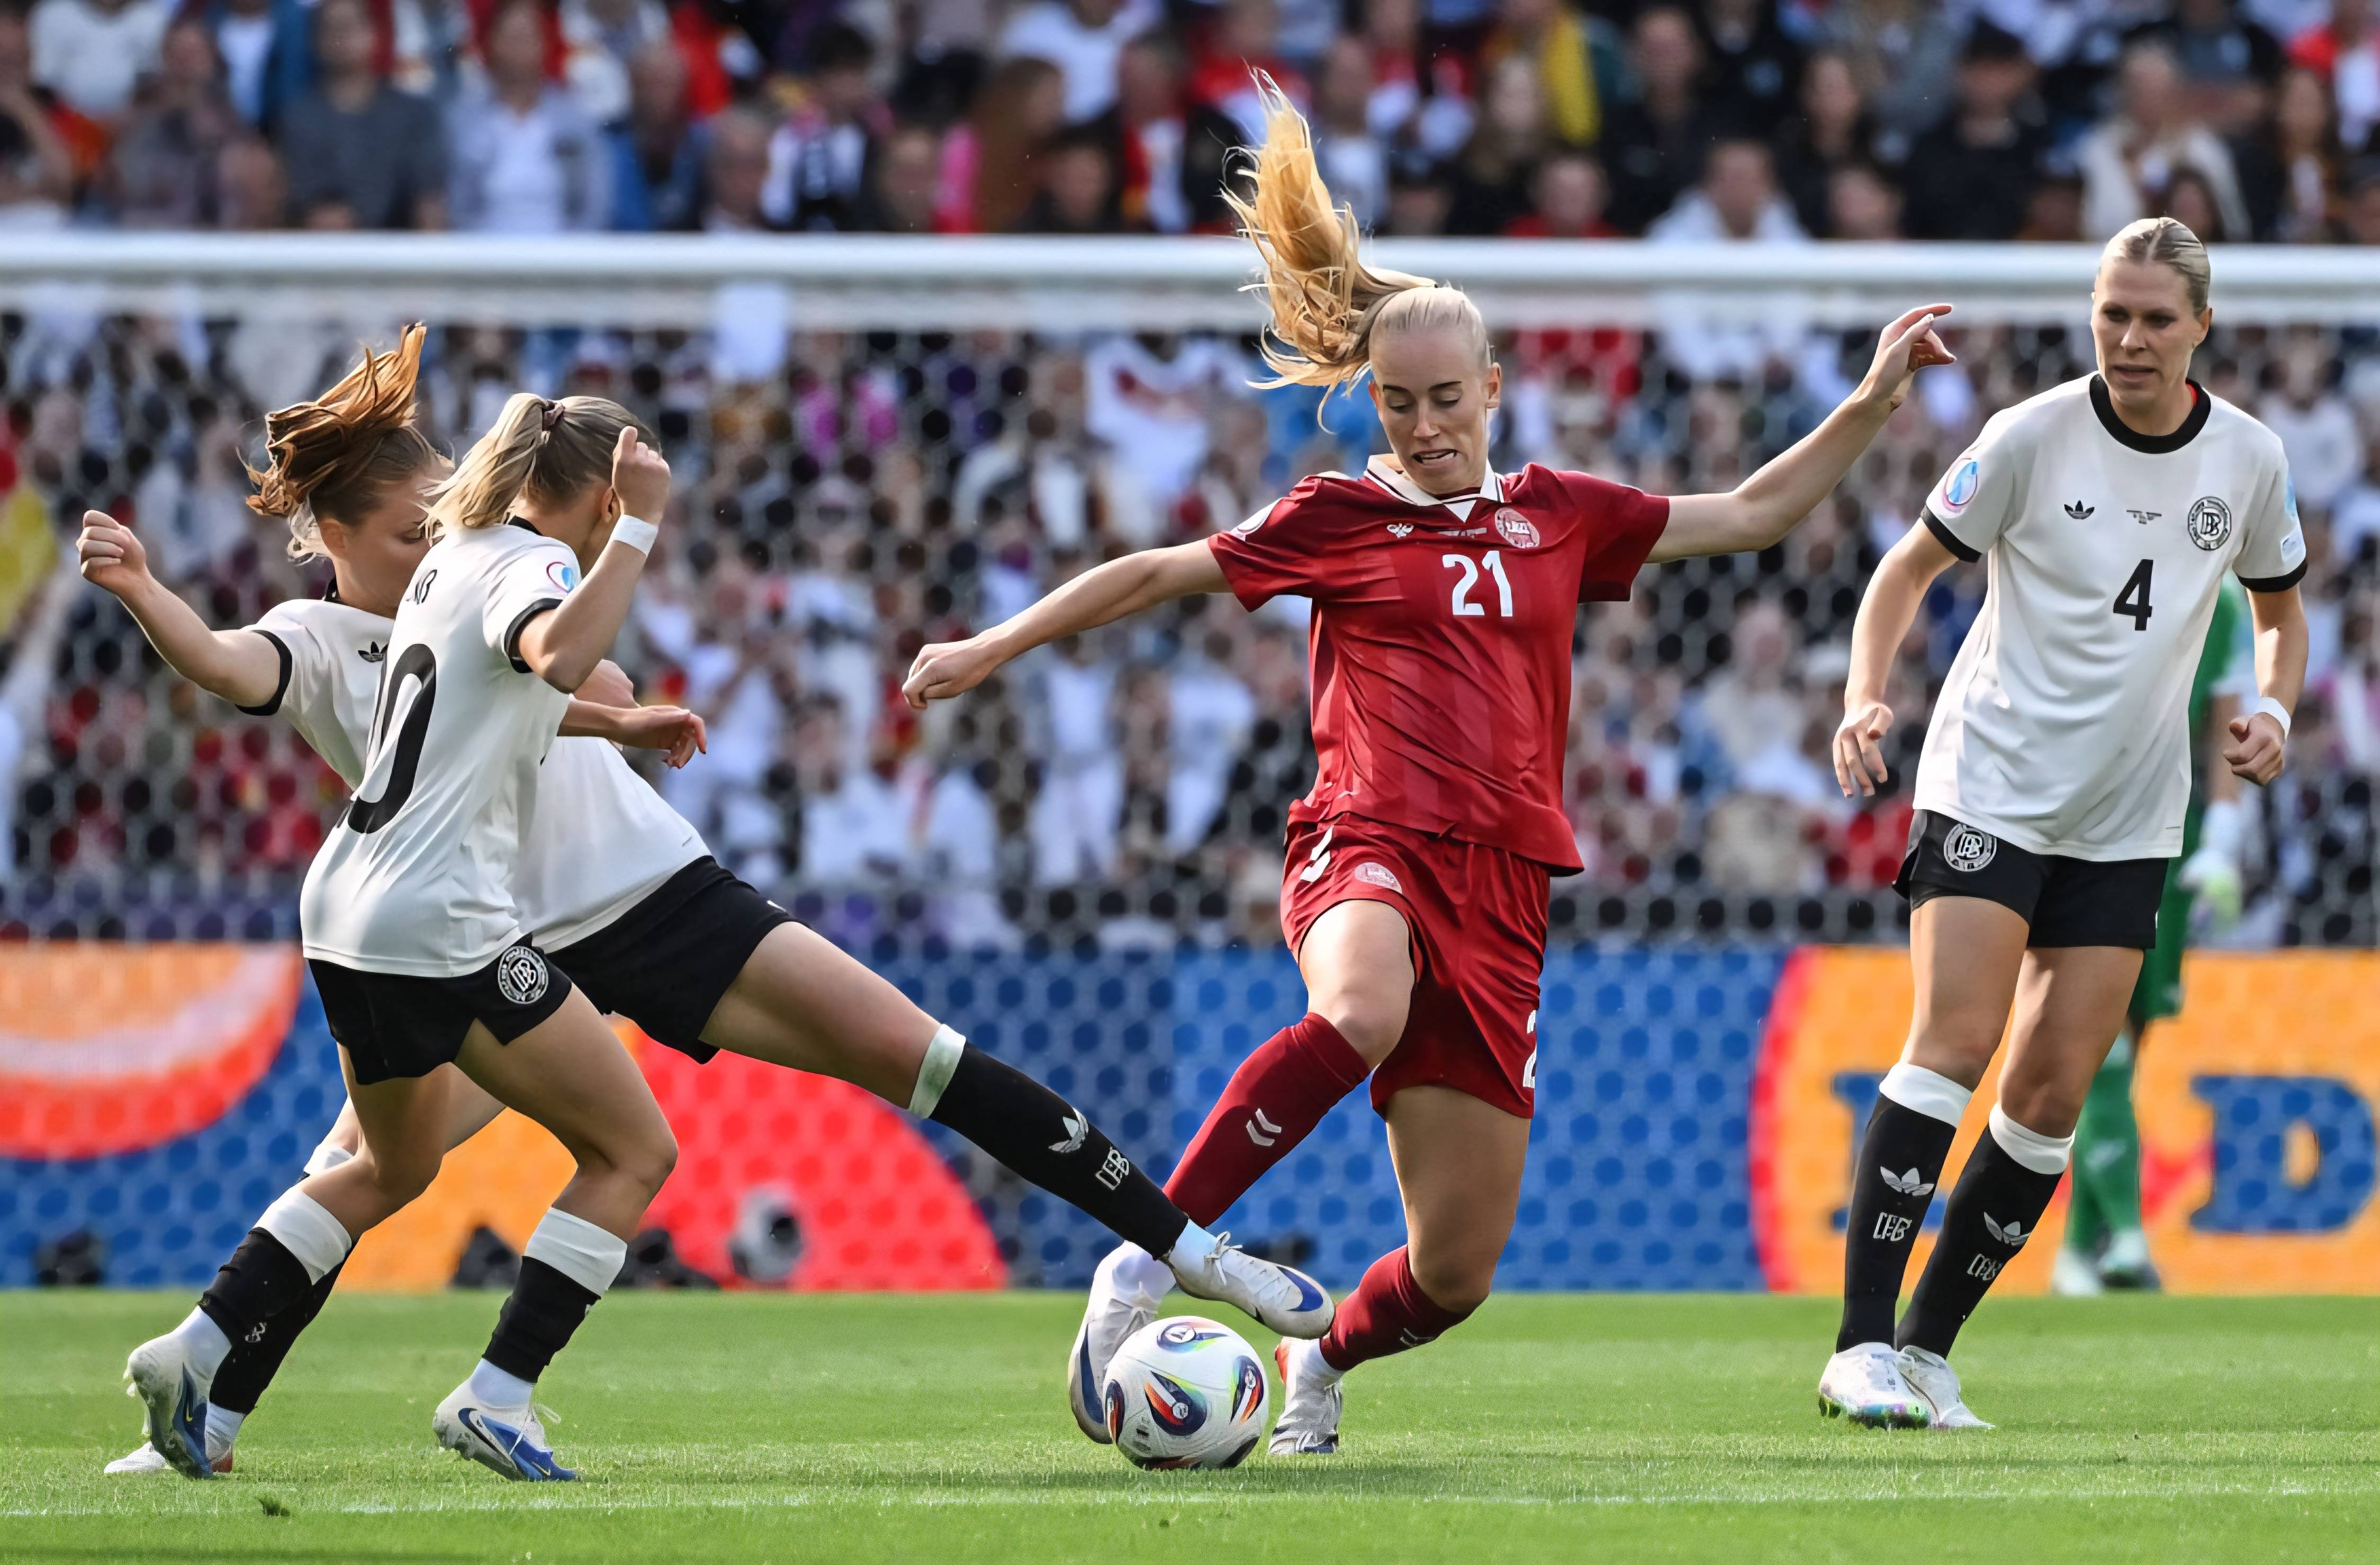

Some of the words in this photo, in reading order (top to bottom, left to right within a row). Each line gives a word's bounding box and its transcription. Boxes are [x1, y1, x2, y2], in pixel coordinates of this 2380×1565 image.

[1443, 551, 1513, 617] 21
[2113, 559, 2154, 631] 4
[336, 643, 437, 834] 0
